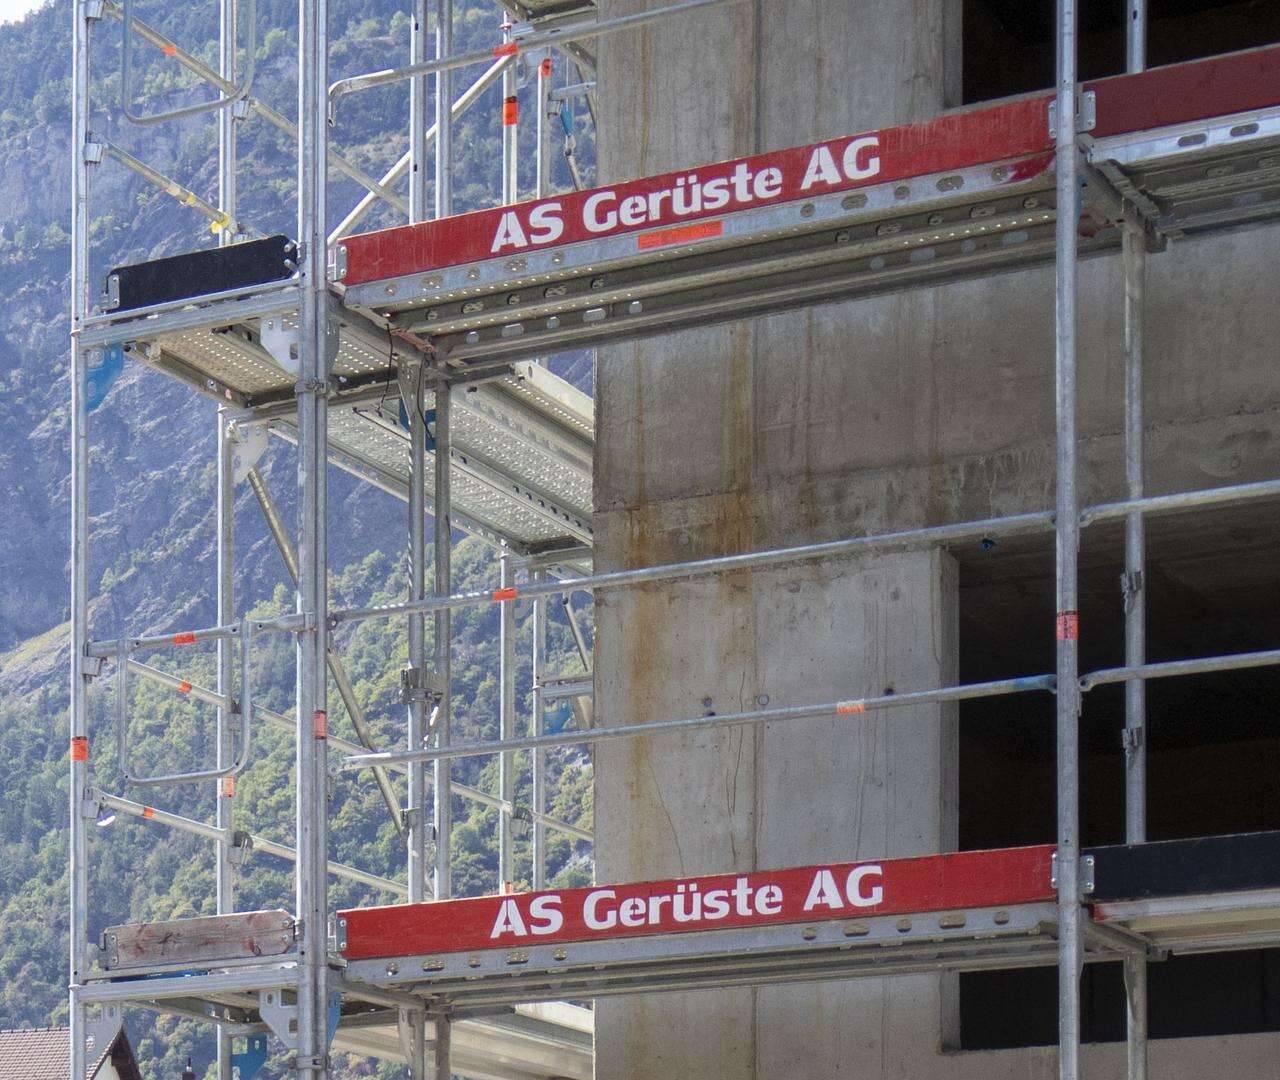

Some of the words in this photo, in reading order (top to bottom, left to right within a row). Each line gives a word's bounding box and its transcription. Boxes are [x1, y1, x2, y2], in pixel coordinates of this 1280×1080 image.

[490, 202, 565, 253] AS
[583, 162, 783, 232] Gerüste
[800, 136, 881, 190] AG
[490, 895, 564, 939] AS
[583, 877, 783, 930] Gerüste
[803, 865, 883, 911] AG
